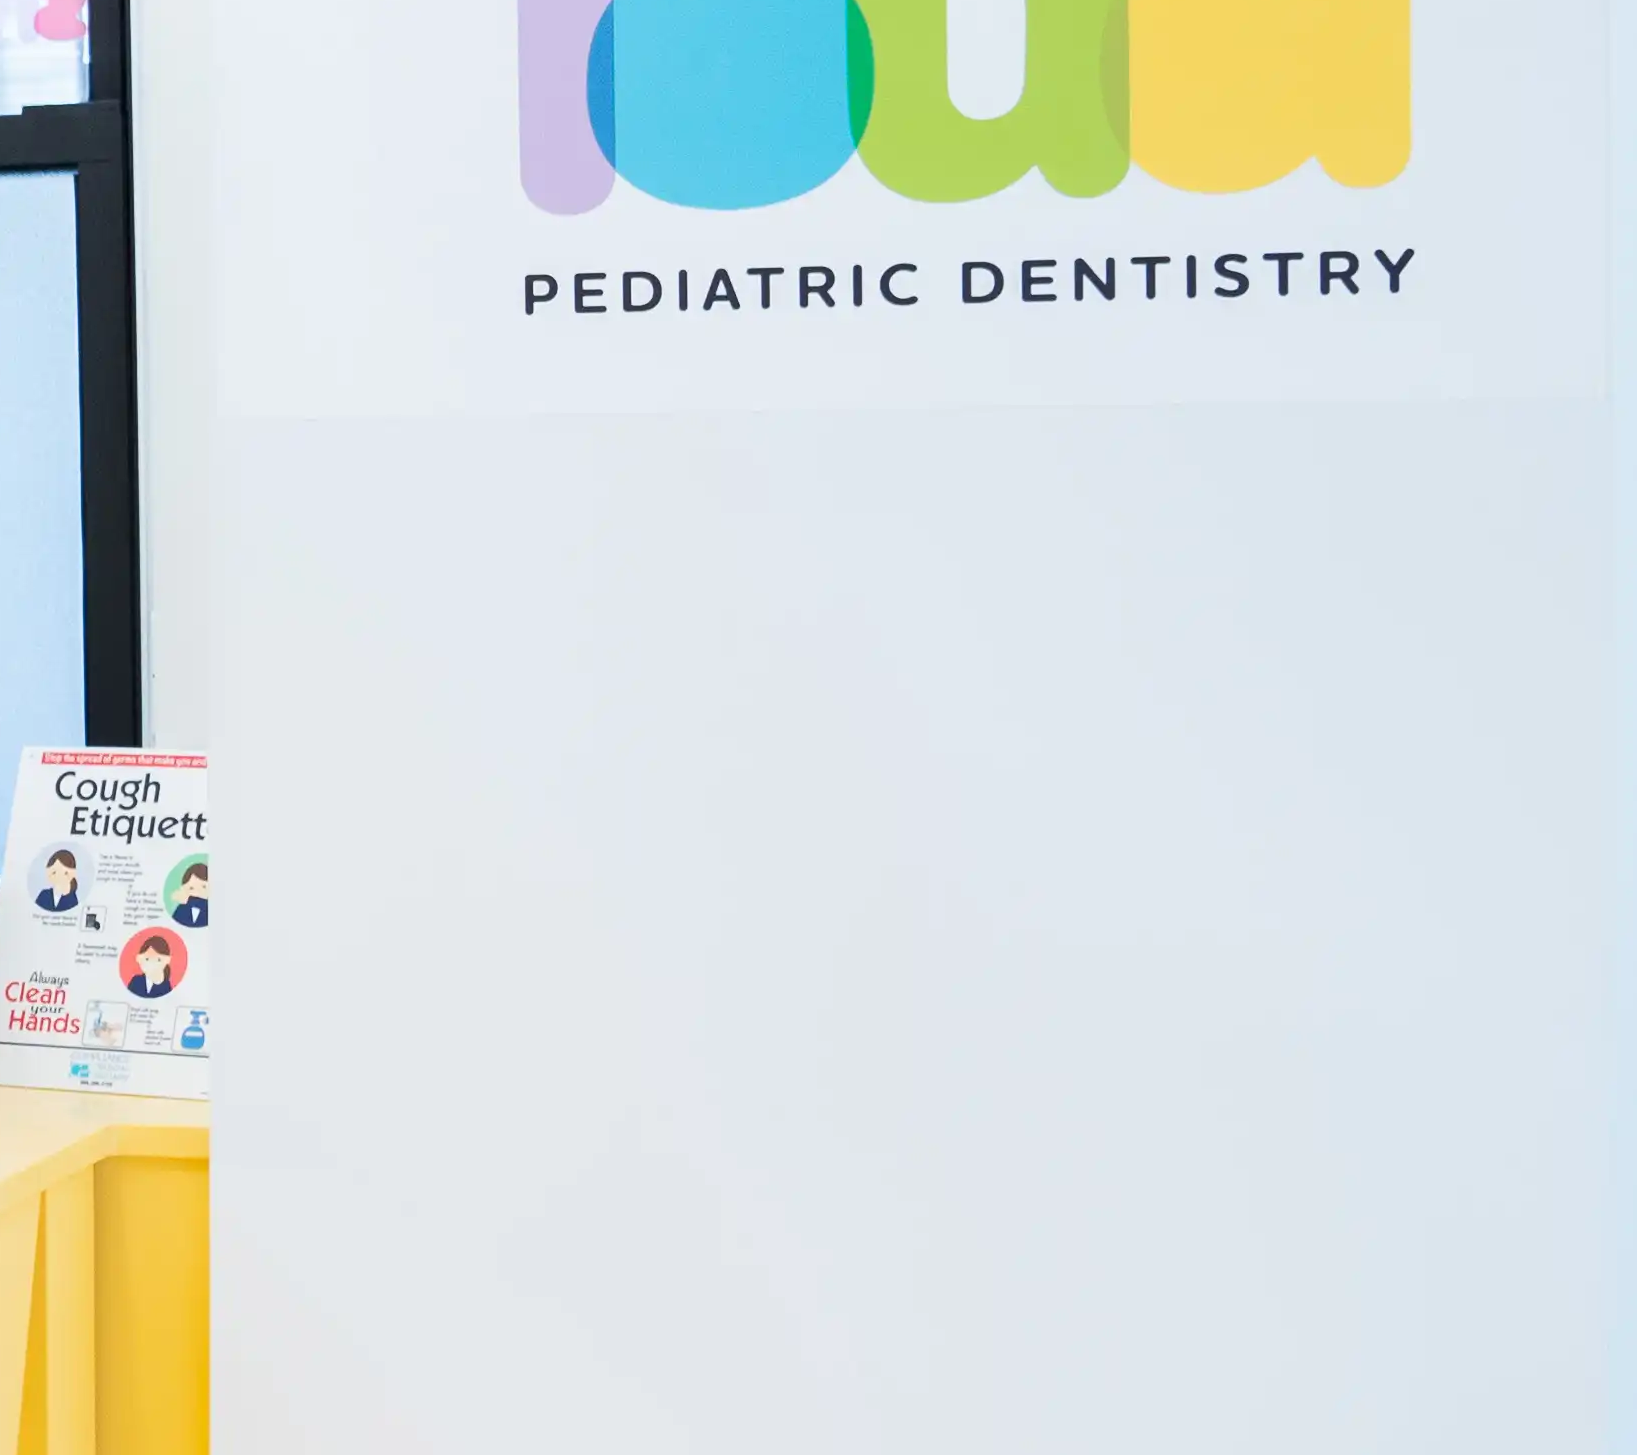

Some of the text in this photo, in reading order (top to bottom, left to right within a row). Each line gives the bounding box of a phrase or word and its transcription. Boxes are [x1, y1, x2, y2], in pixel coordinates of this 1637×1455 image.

[524, 248, 1415, 316] PEDIATRIC DENTISTRY
[55, 771, 161, 810] Cough
[70, 806, 208, 844] Etiquett
[29, 971, 69, 987] Always
[5, 982, 66, 1005] Clean
[9, 1009, 81, 1034] Hands
[30, 1005, 65, 1015] your
